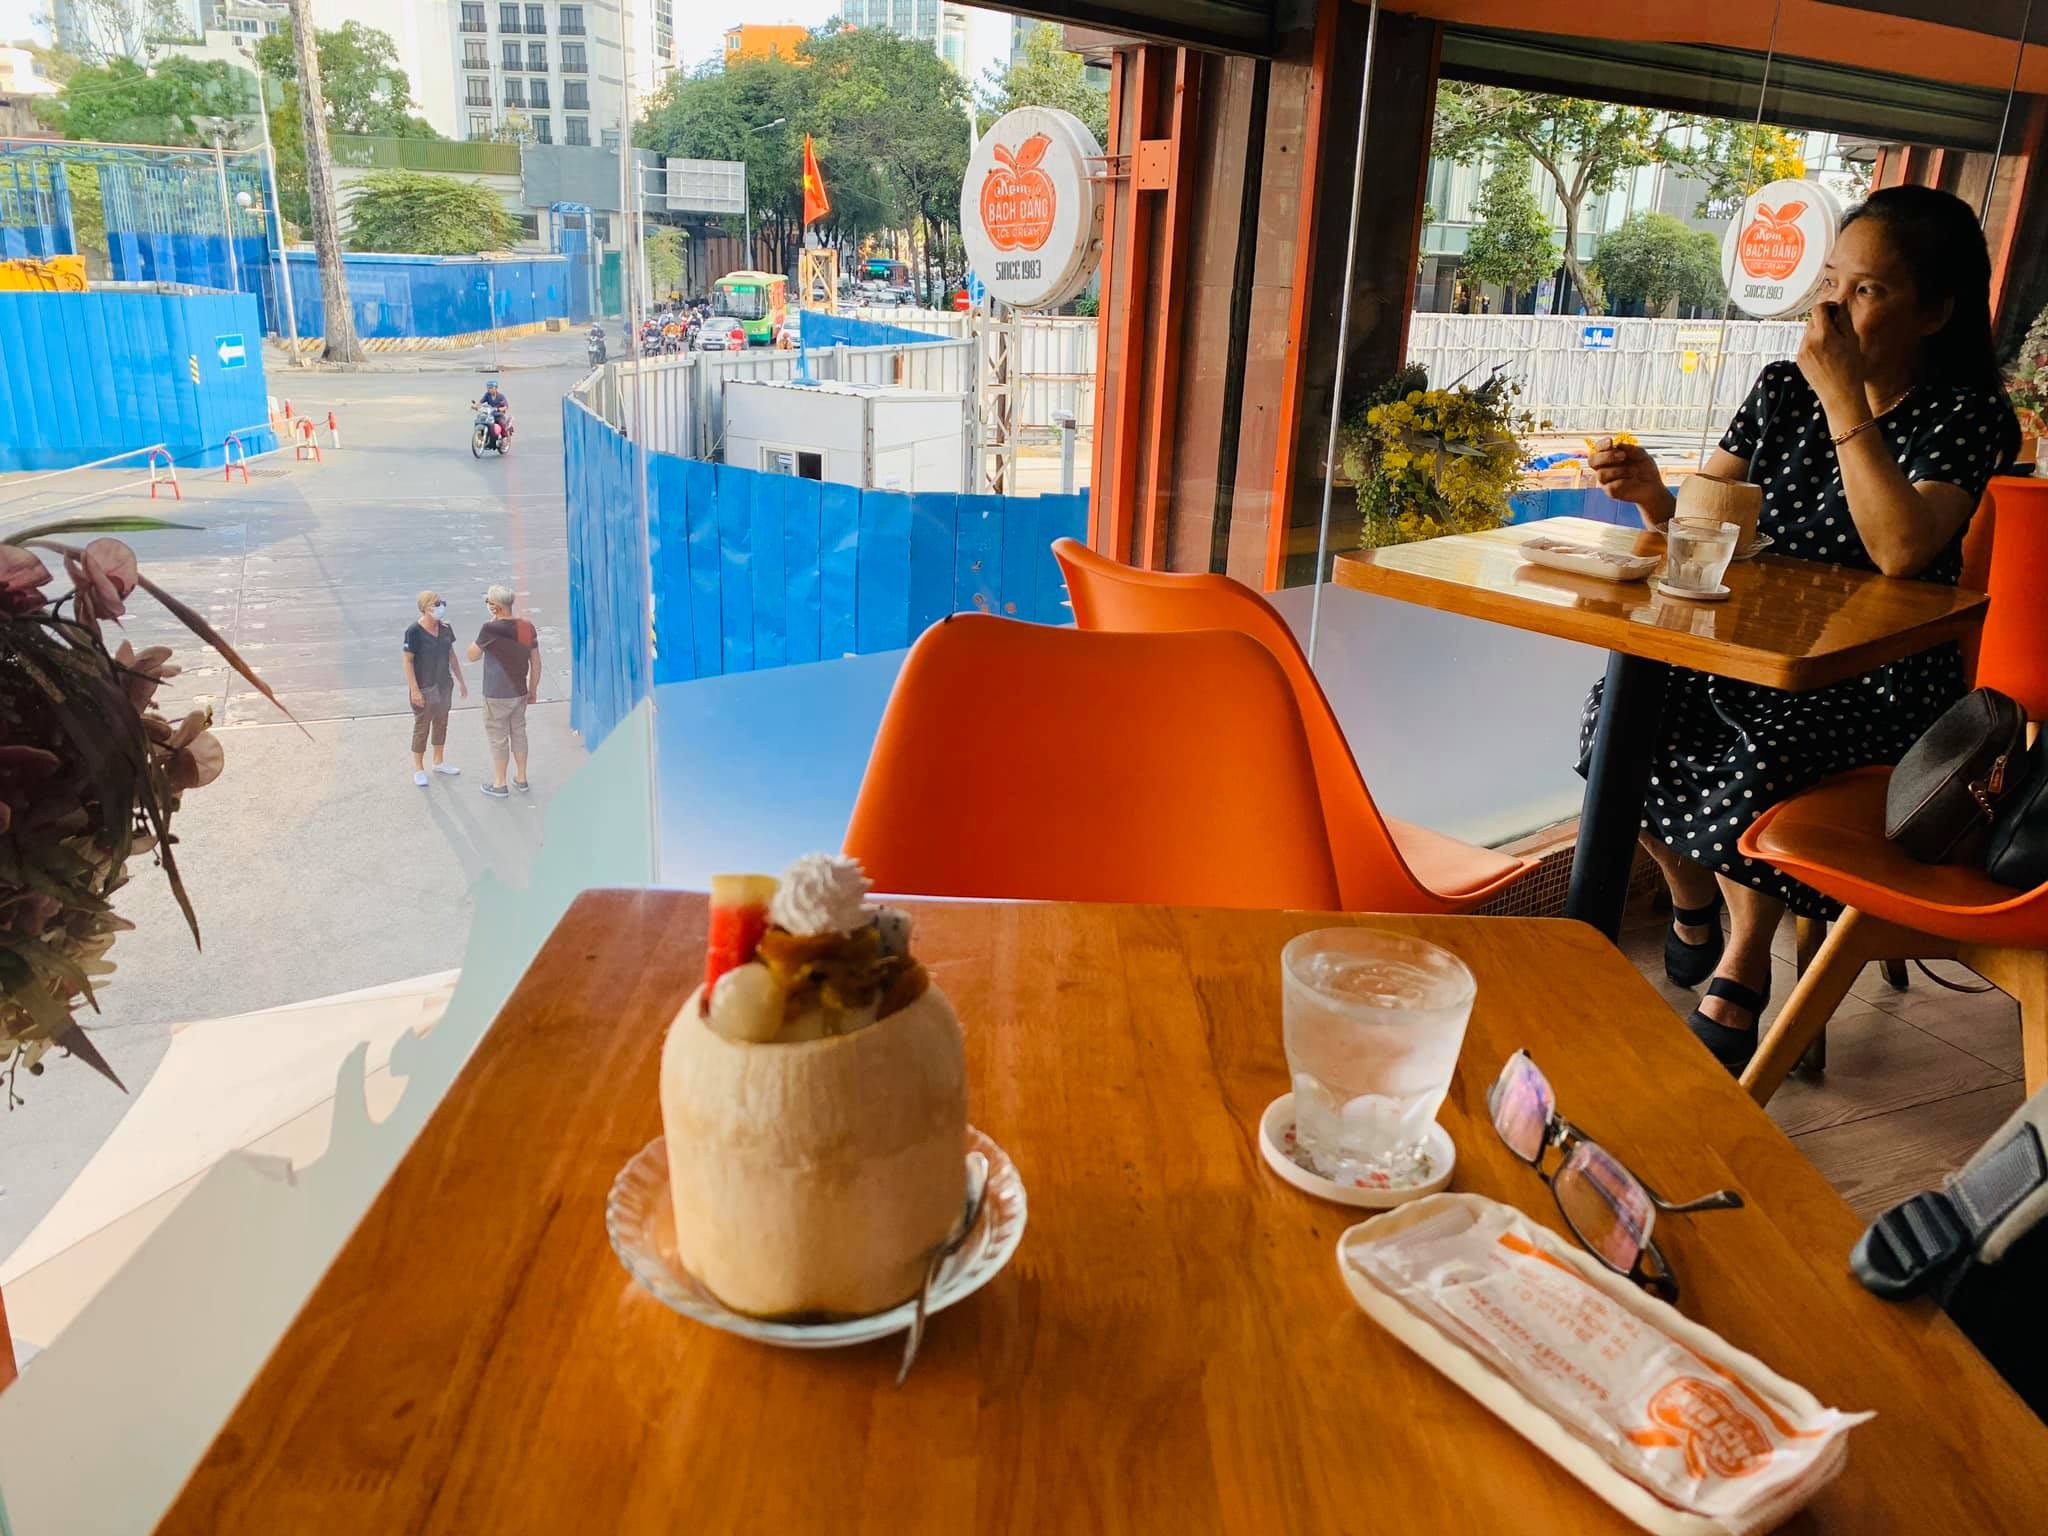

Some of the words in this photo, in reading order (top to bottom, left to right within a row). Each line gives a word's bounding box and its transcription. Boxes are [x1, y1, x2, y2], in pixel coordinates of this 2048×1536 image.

[996, 260, 1020, 281] SINCE
[1022, 259, 1042, 280] 1983
[1743, 284, 1766, 299] SINCE
[1766, 285, 1784, 300] 1983
